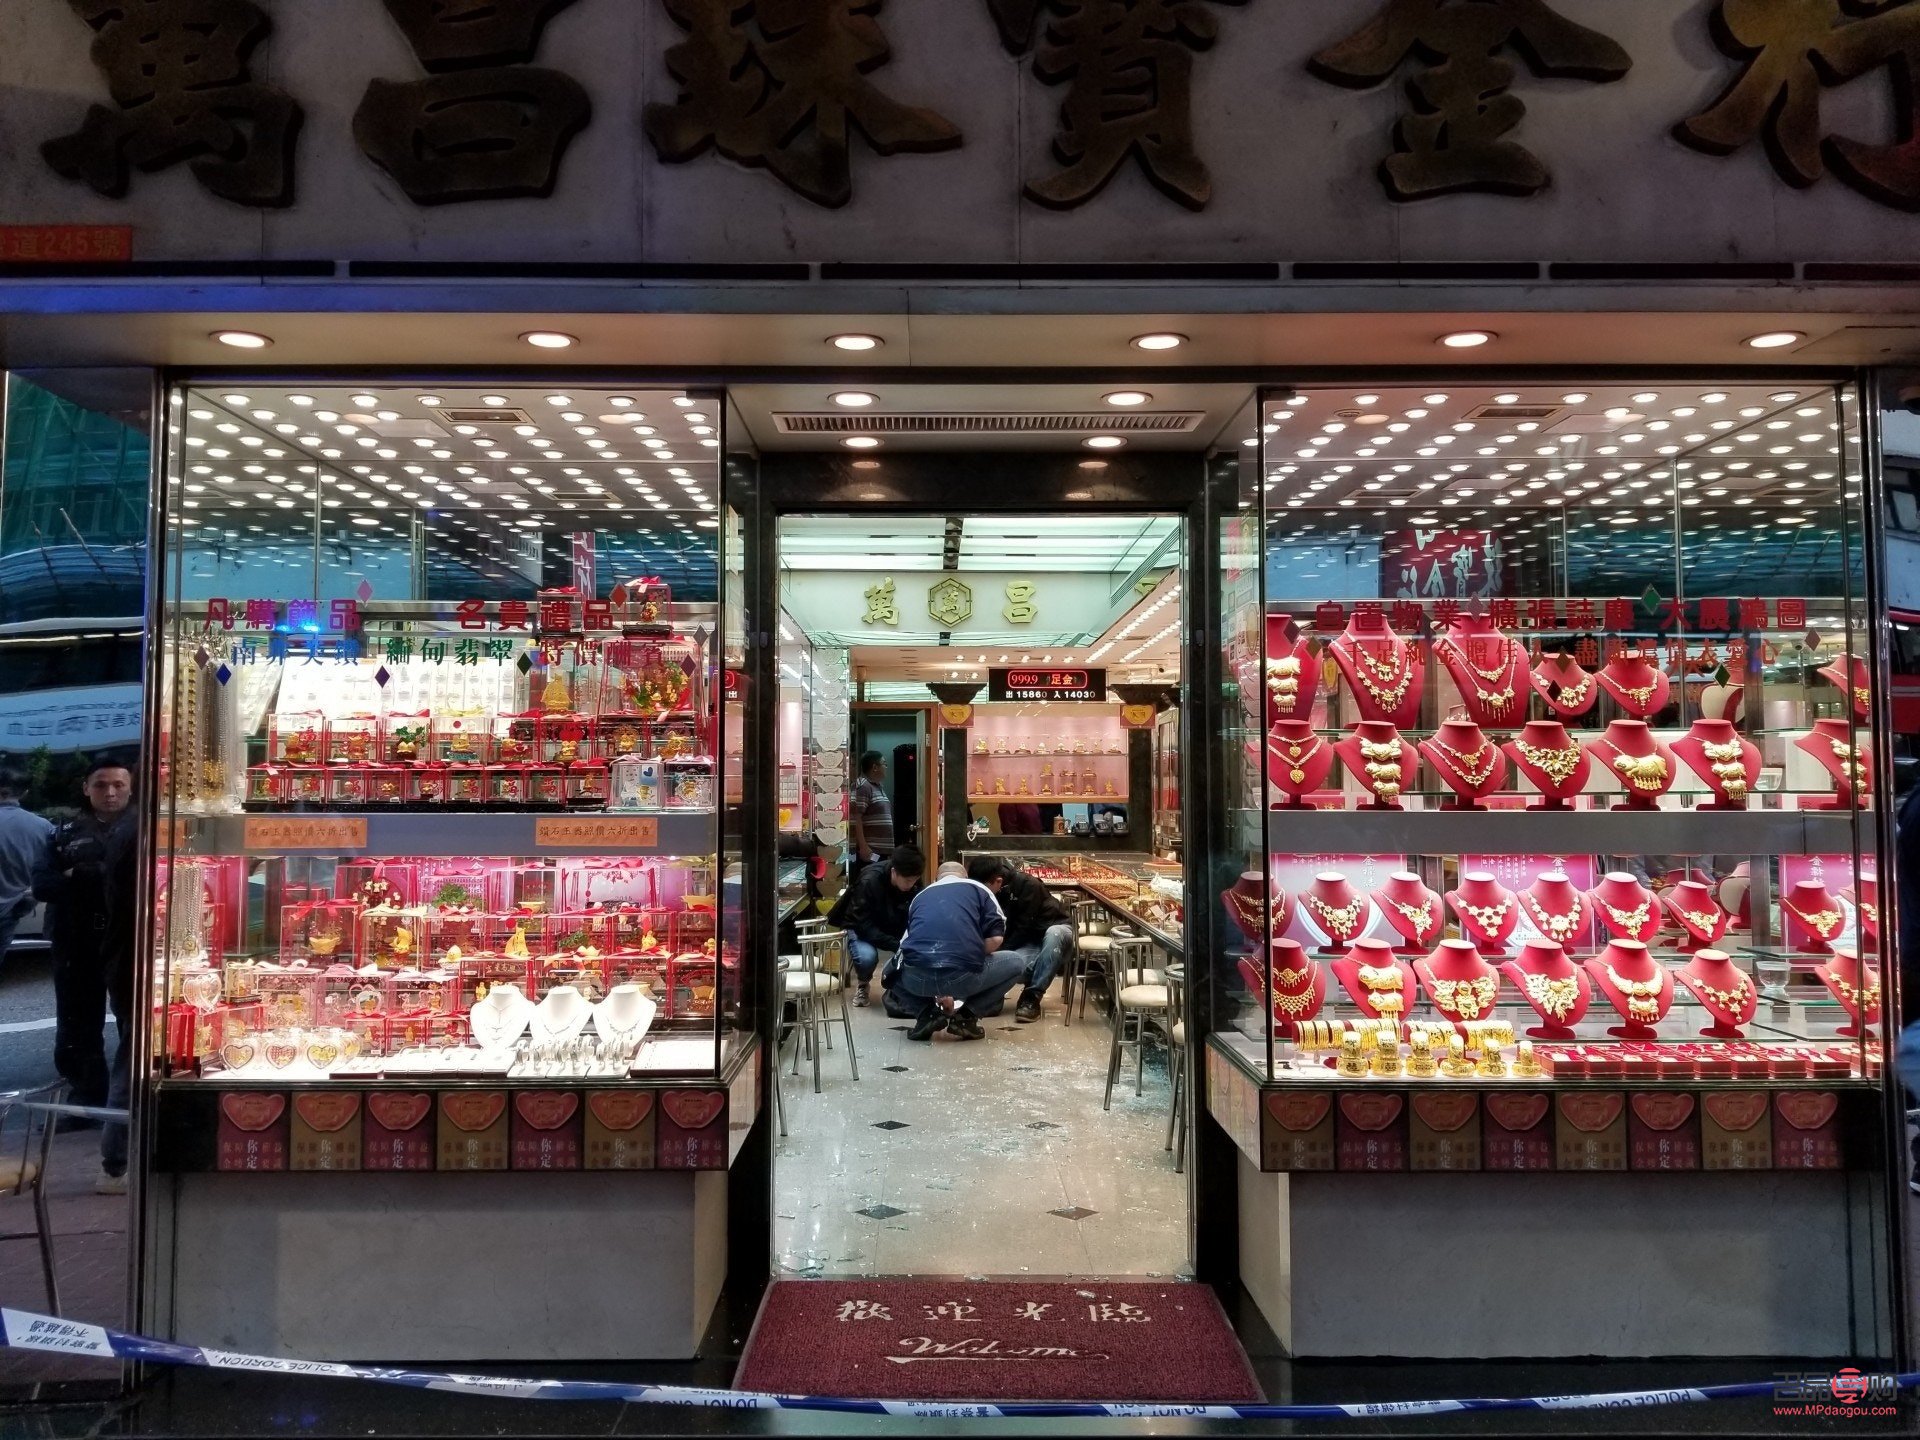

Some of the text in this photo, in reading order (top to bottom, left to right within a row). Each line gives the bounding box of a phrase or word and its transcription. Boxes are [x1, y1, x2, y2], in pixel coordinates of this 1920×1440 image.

[0, 229, 120, 257] 道245號
[204, 597, 613, 630] 凡購飾品 名貴禮品
[861, 576, 900, 626] 萬
[1001, 580, 1039, 625] 昌
[1315, 600, 1460, 631] 自置物業
[1660, 597, 1806, 630] 大展鴻圖
[1011, 674, 1038, 685] 999.9
[836, 1300, 1150, 1322] 歡迎光臨
